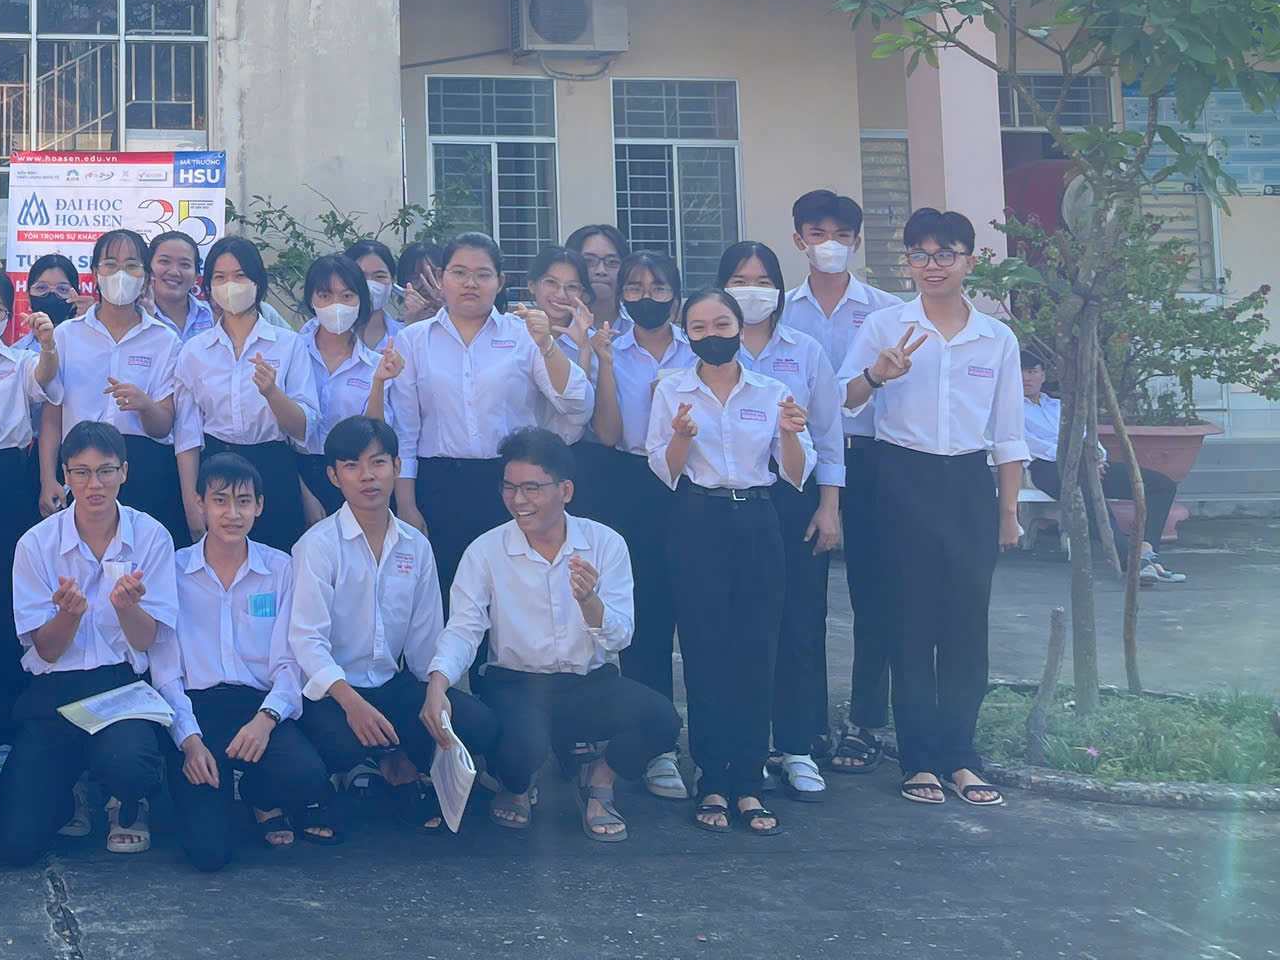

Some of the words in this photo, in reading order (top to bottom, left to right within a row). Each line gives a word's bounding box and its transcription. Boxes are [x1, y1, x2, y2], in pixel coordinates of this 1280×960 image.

[16, 154, 118, 162] www.hoasen.edu.vn
[180, 168, 220, 184] HSU
[55, 214, 89, 226] HOA
[93, 214, 122, 228] SEN
[138, 199, 216, 247] 35
